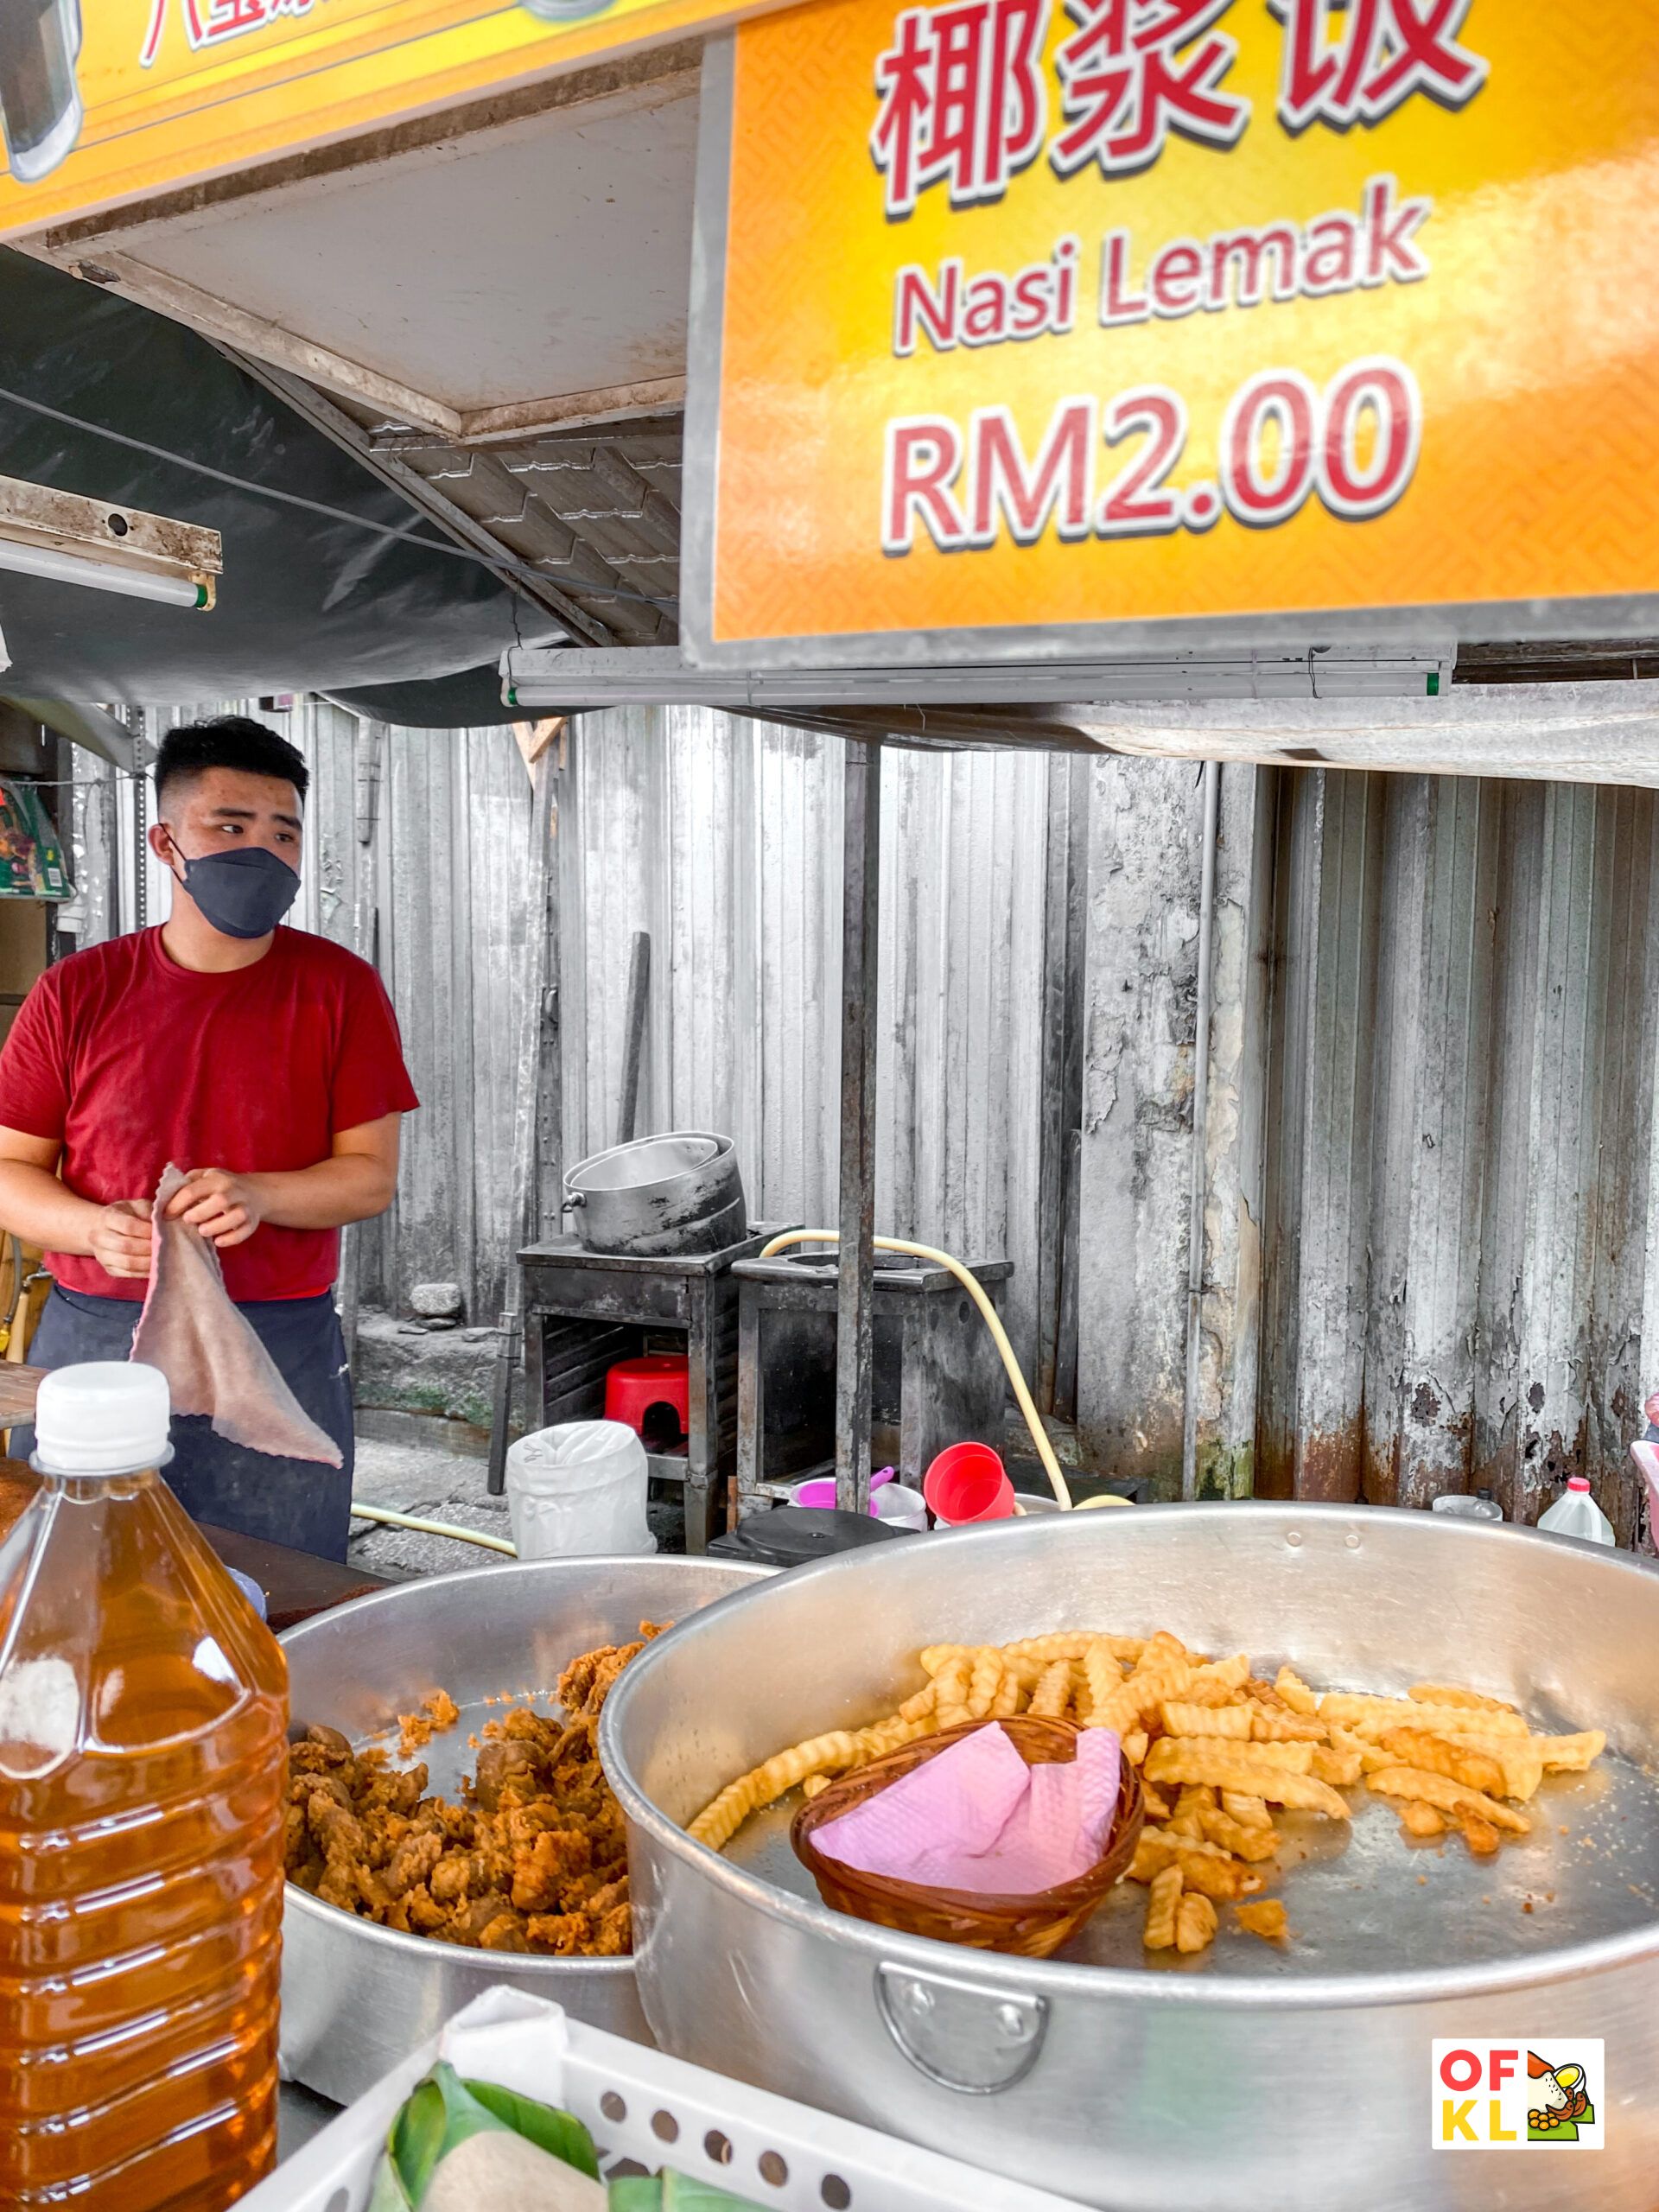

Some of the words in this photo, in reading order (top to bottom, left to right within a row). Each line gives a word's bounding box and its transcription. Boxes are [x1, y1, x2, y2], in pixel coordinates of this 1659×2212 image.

[894, 236, 1077, 354] Nasi
[1101, 175, 1429, 325] Lemak
[883, 358, 1420, 550] RM2.00
